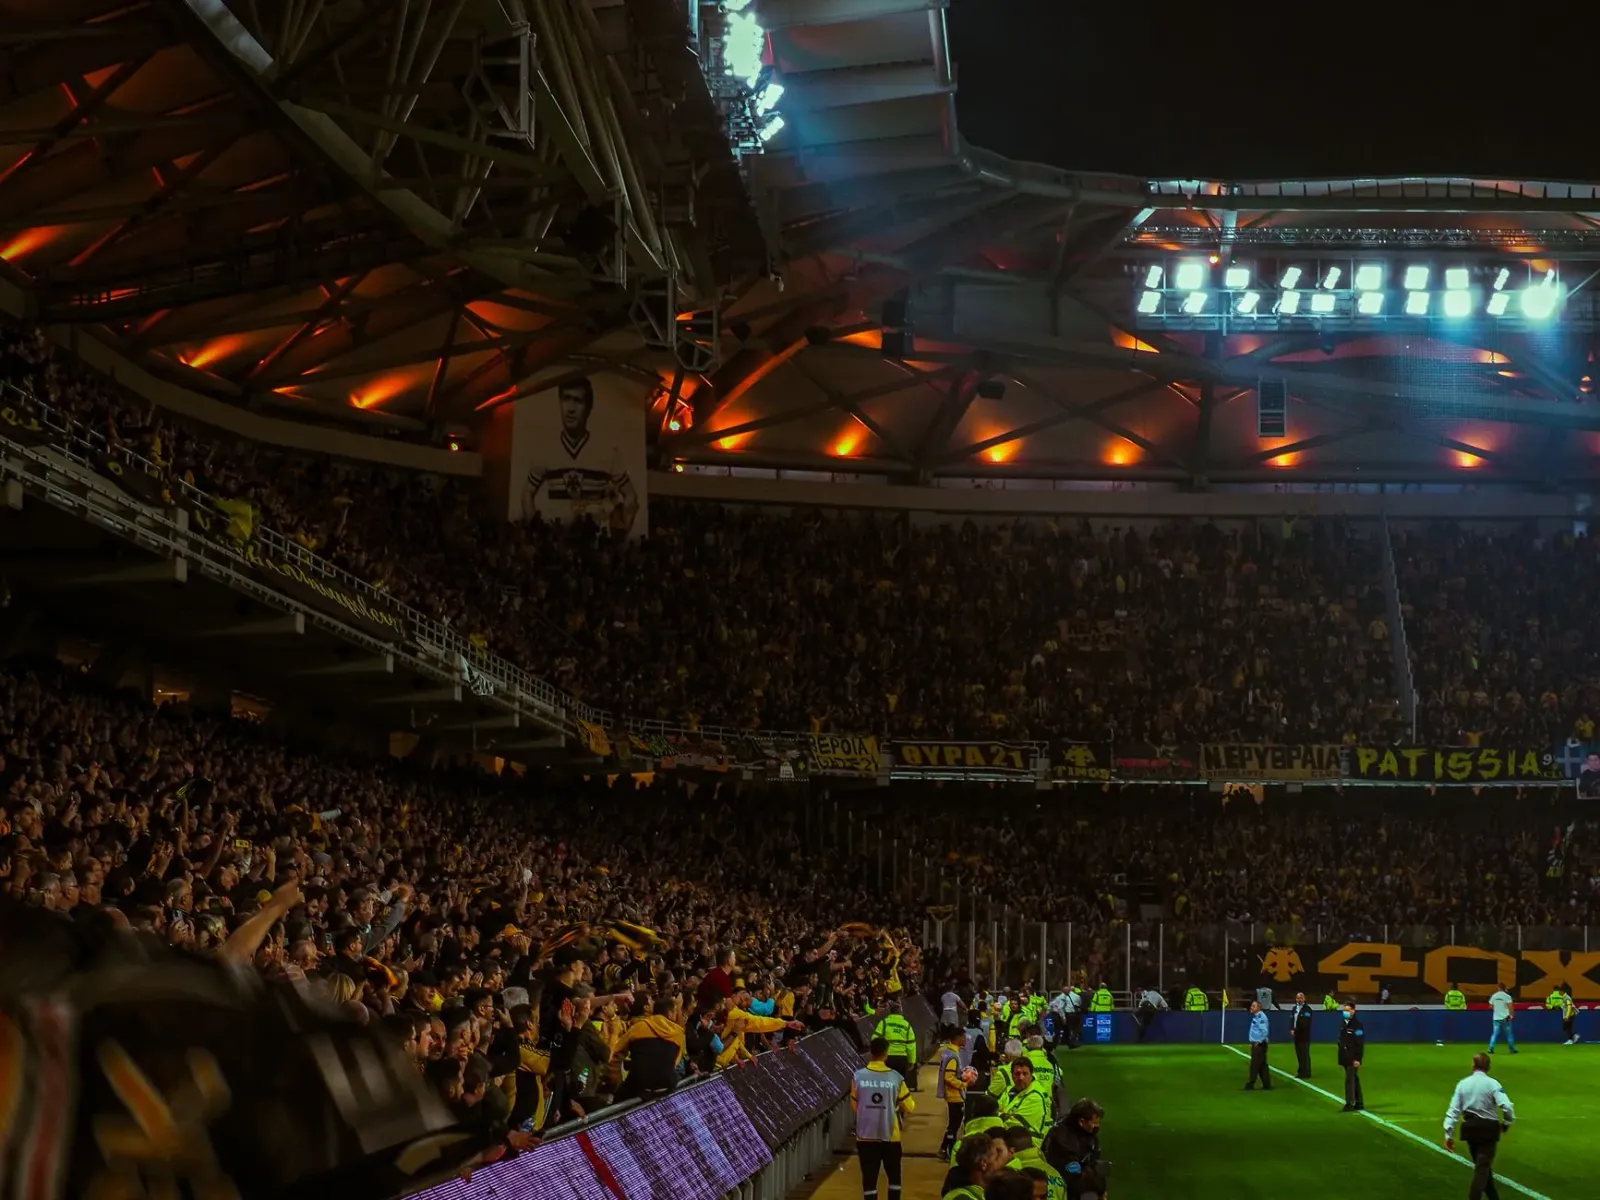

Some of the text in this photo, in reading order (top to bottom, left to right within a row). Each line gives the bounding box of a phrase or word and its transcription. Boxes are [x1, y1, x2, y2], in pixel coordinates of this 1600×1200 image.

[901, 744, 1025, 769] ΘΥΡΑ 21
[1355, 746, 1540, 781] PATISSIA
[860, 1079, 895, 1089] BALL BOY
